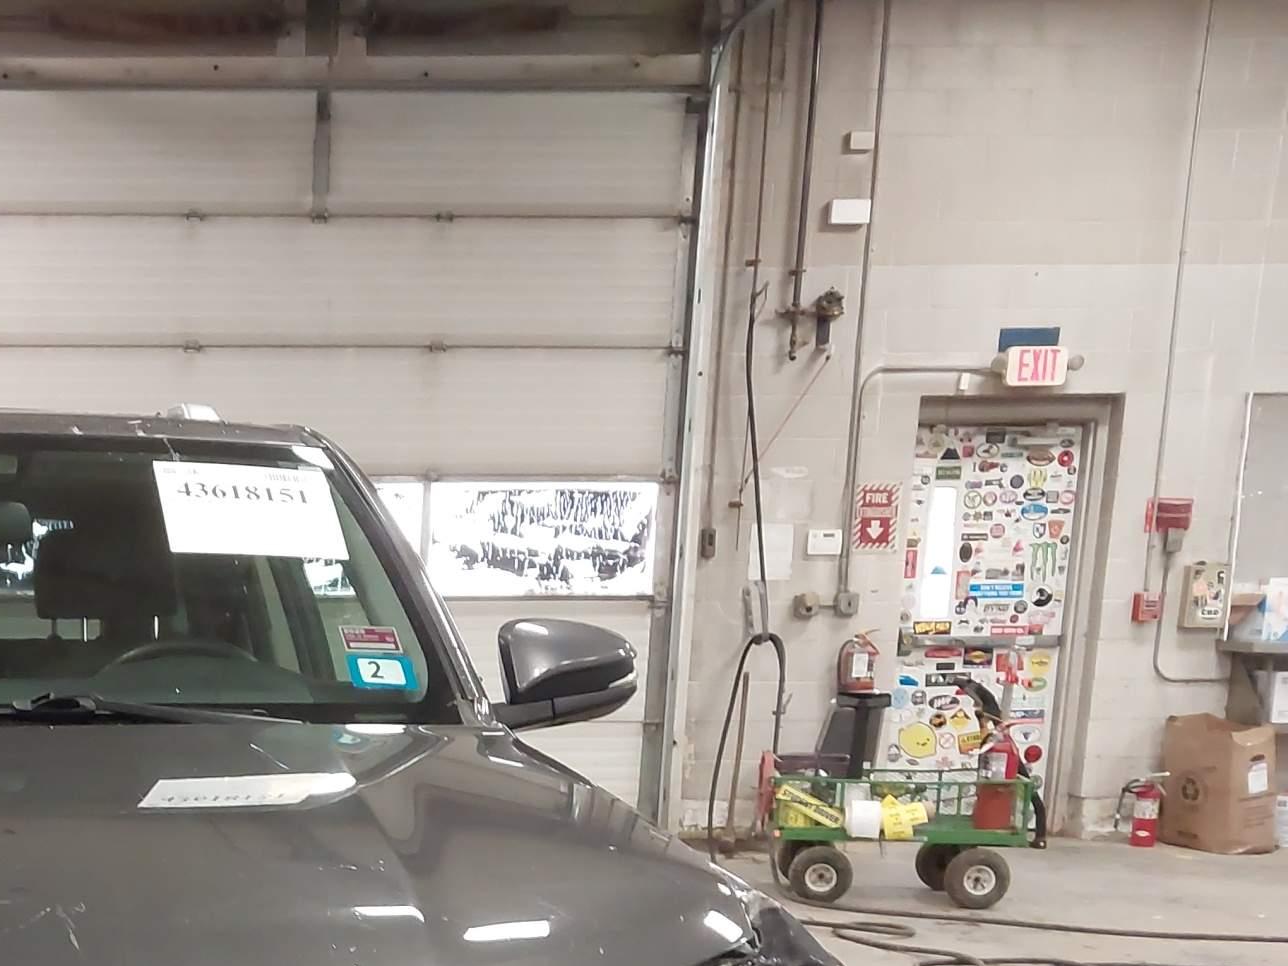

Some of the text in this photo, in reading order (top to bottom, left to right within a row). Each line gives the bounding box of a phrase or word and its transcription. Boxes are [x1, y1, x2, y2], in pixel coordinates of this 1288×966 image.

[1017, 349, 1061, 381] EXIT
[177, 482, 307, 504] 43618151
[865, 492, 889, 504] FIRE
[368, 661, 384, 679] 2
